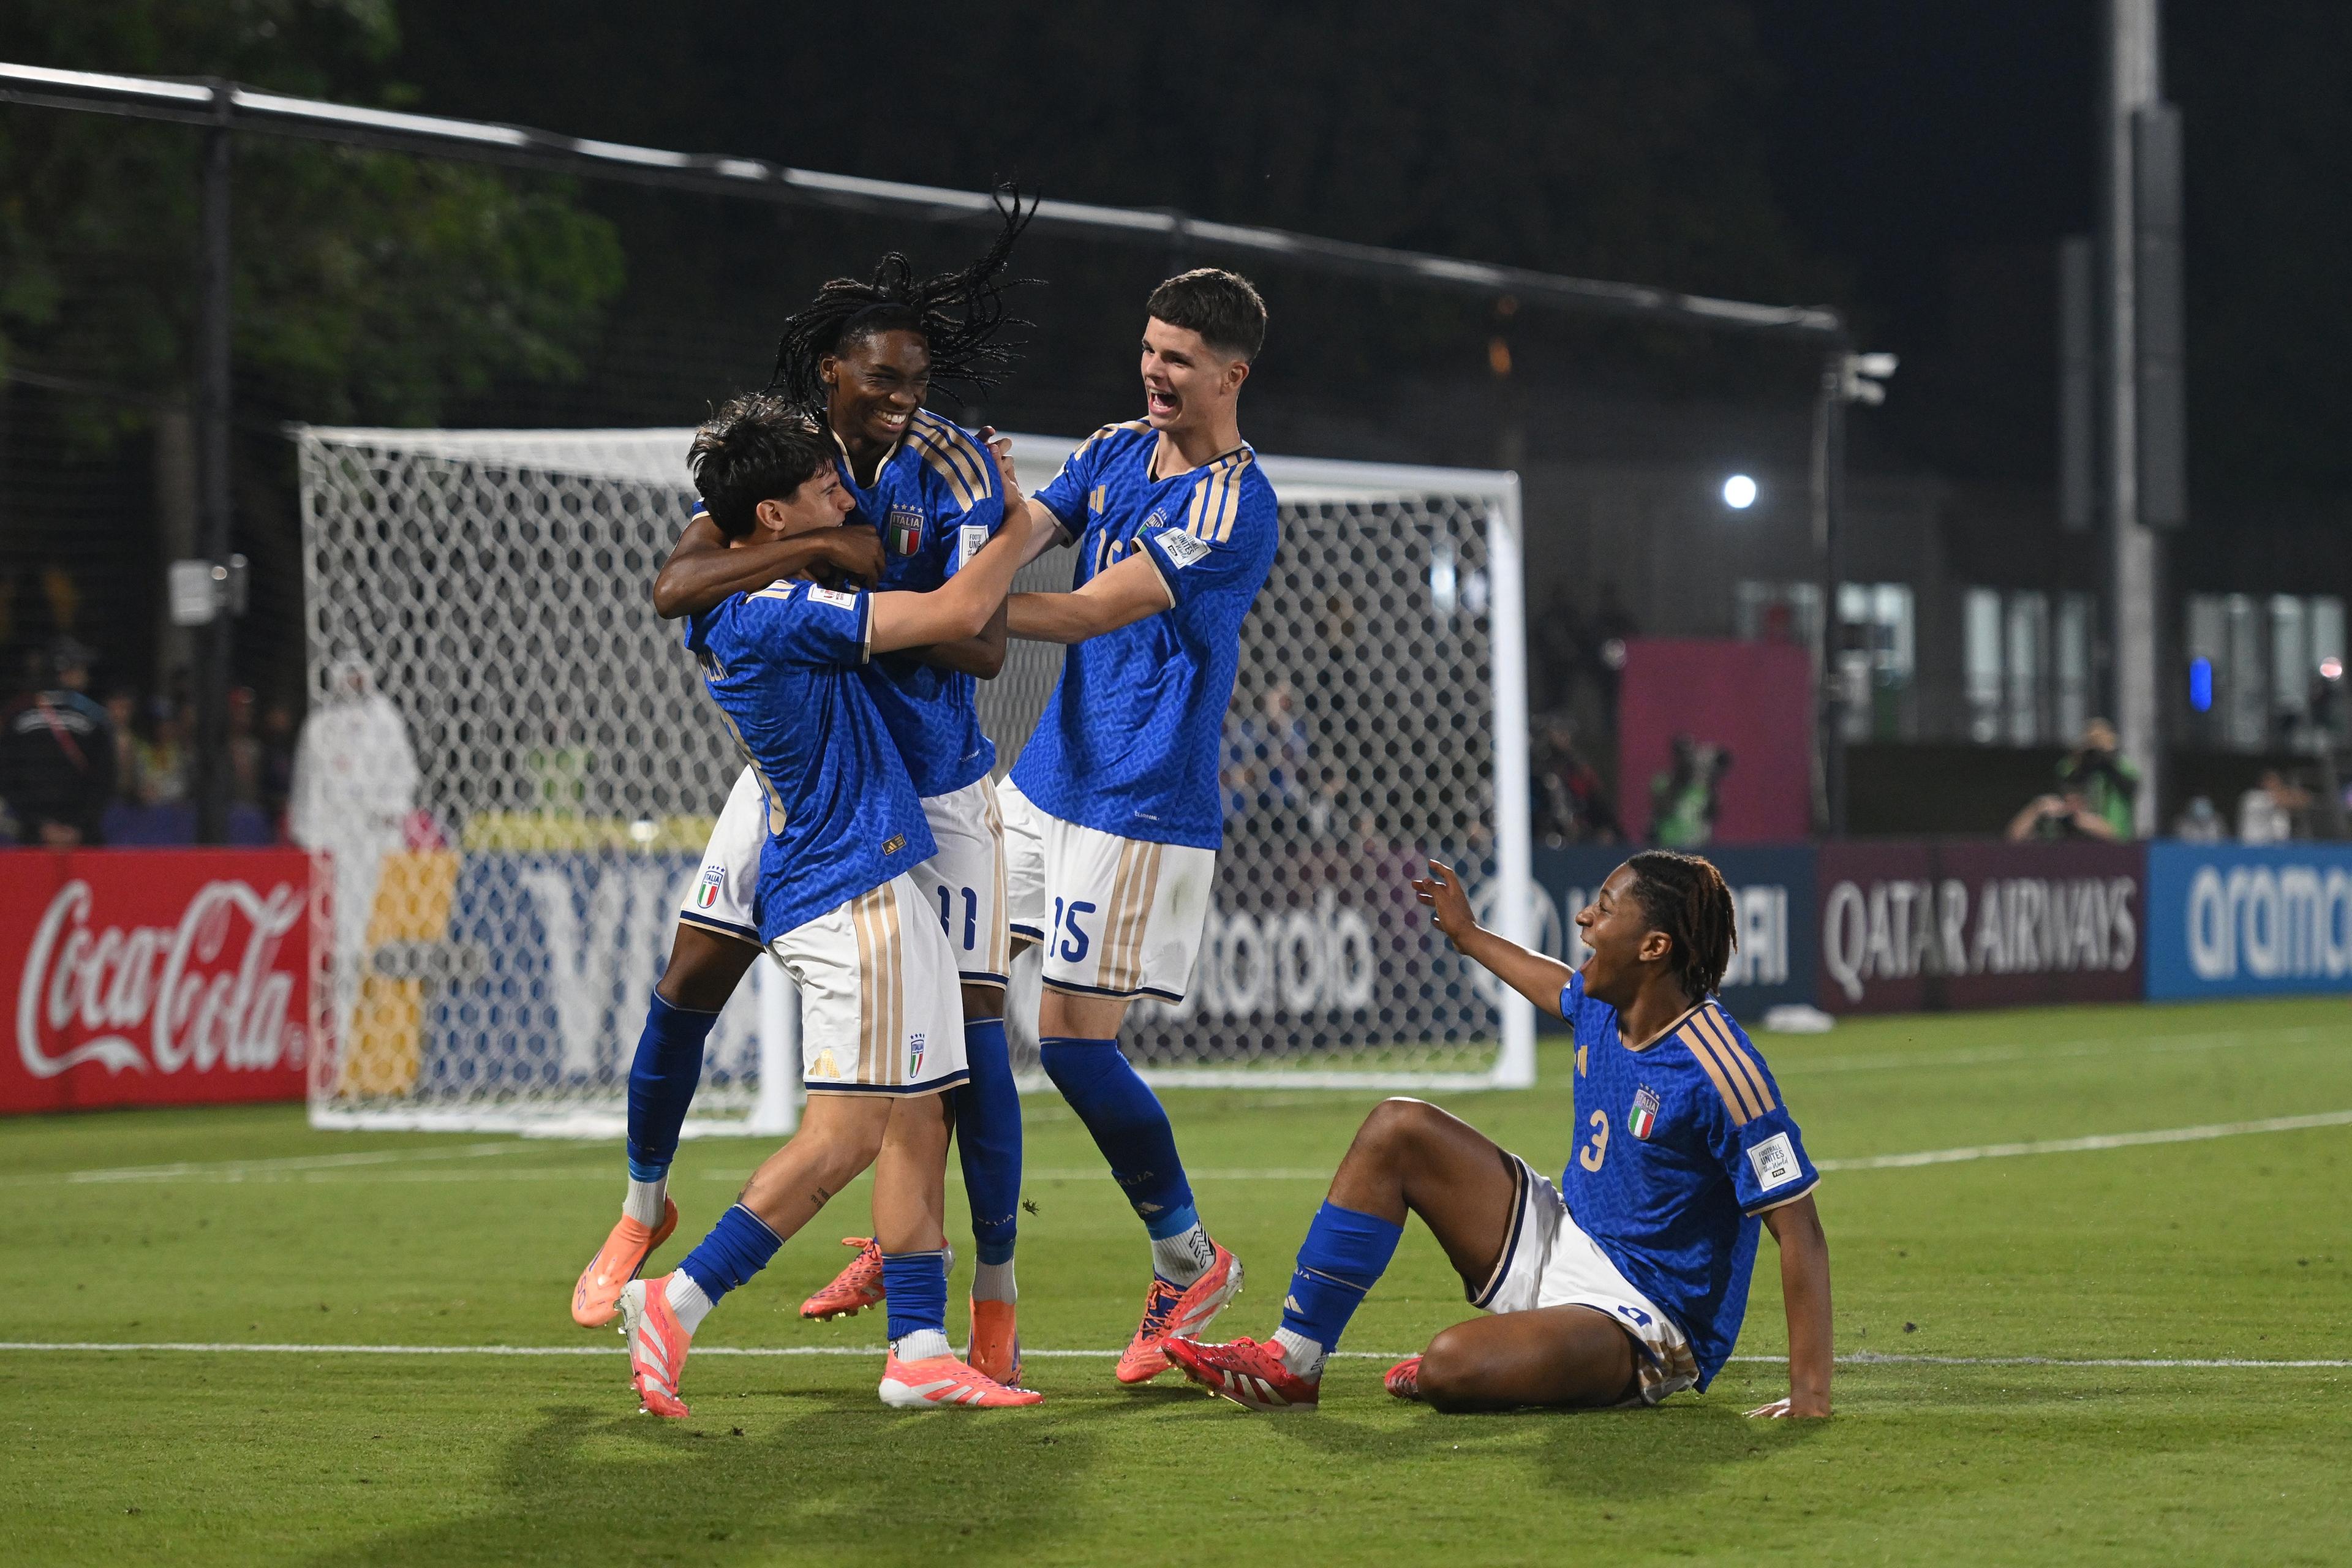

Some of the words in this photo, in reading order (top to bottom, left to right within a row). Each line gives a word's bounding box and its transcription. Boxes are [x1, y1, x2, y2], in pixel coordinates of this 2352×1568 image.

[892, 514, 920, 527] ITALIA
[1177, 532, 1195, 556] UNITES
[937, 885, 978, 951] 11
[1049, 896, 1096, 963] 15
[2185, 864, 2352, 980] aramc
[1823, 878, 1968, 1003] QATAR
[1970, 876, 2137, 975] AIRWAYS
[1580, 1109, 1610, 1172] 3
[1758, 1144, 1782, 1158] FOOTBALL
[1760, 1149, 1785, 1166] UNITES
[1772, 1157, 1789, 1169] World
[1773, 1168, 1785, 1177] FIFA
